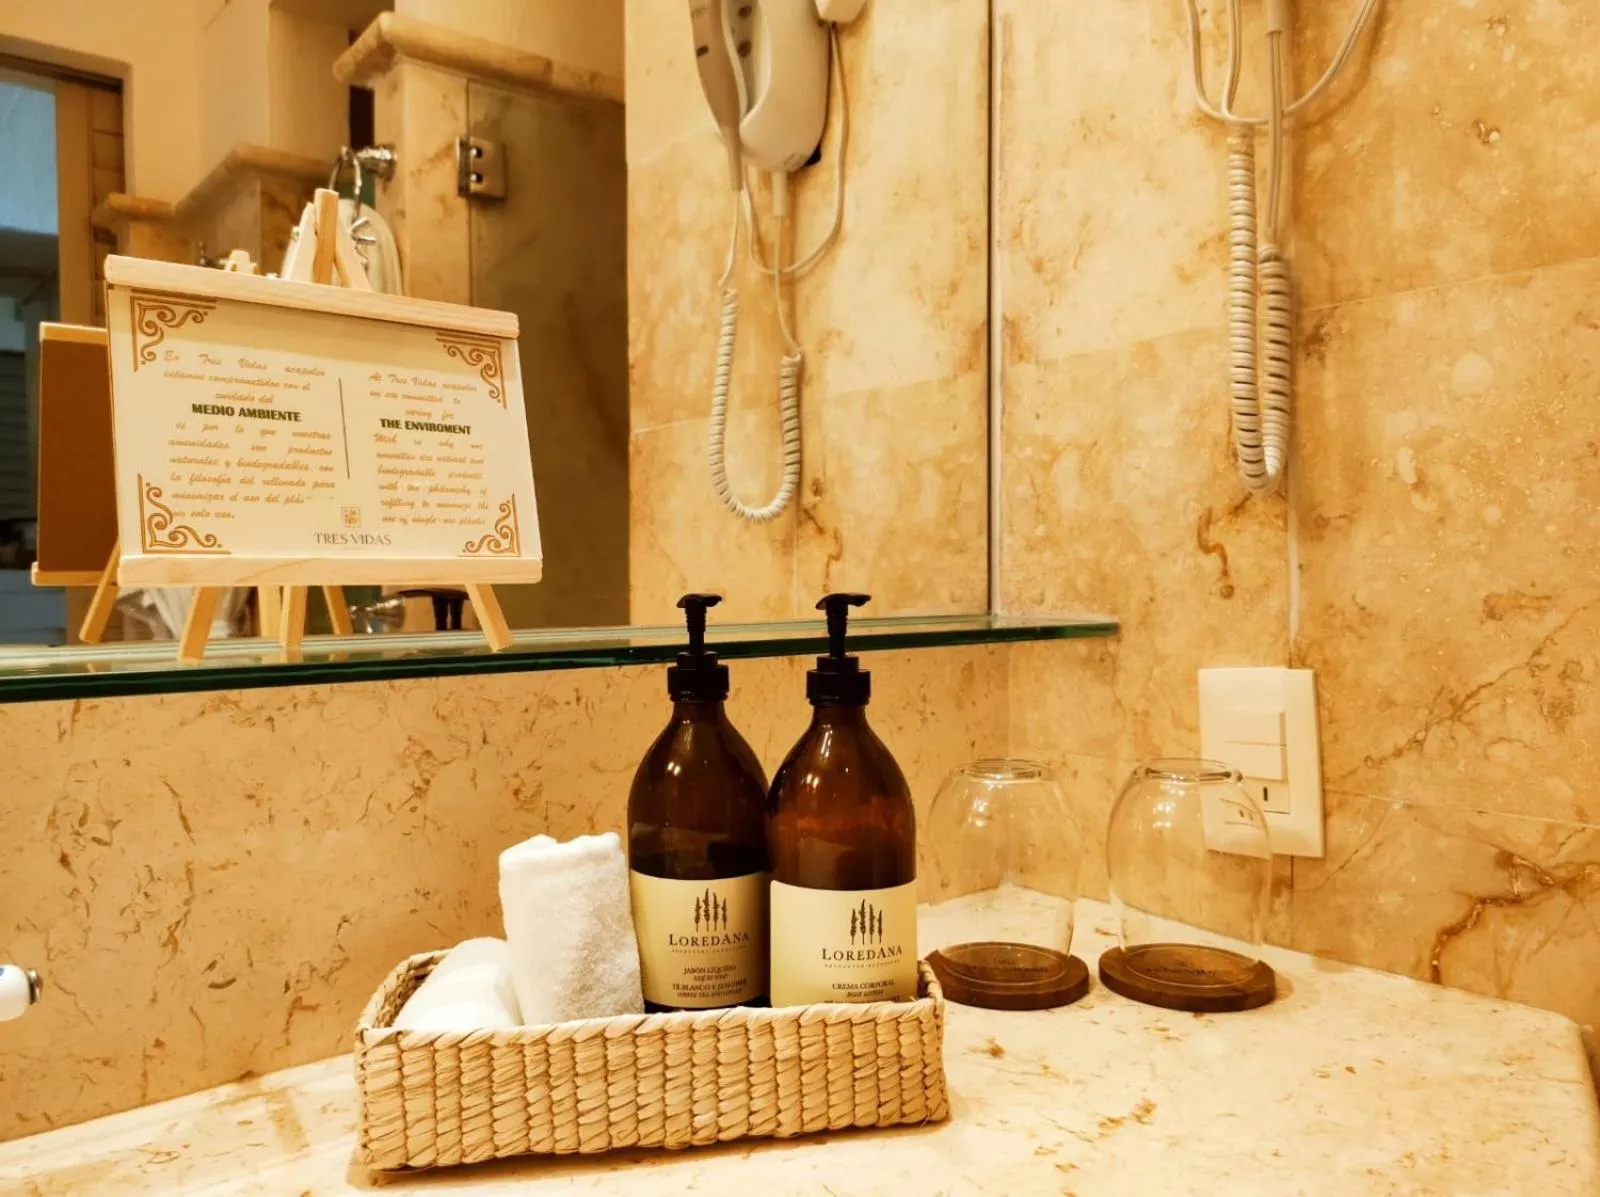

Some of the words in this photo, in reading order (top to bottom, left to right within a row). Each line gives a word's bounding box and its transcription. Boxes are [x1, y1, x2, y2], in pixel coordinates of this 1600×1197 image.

[198, 354, 221, 365] Tres
[238, 358, 268, 370] Vidas
[192, 404, 235, 416] MEDIO
[238, 409, 302, 422] AMBIENTE
[380, 419, 402, 429] THE
[405, 420, 471, 435] ENVIROMENT
[314, 532, 348, 544] TRES
[351, 534, 392, 545] VIDAS
[822, 945, 902, 960] LOREDANA
